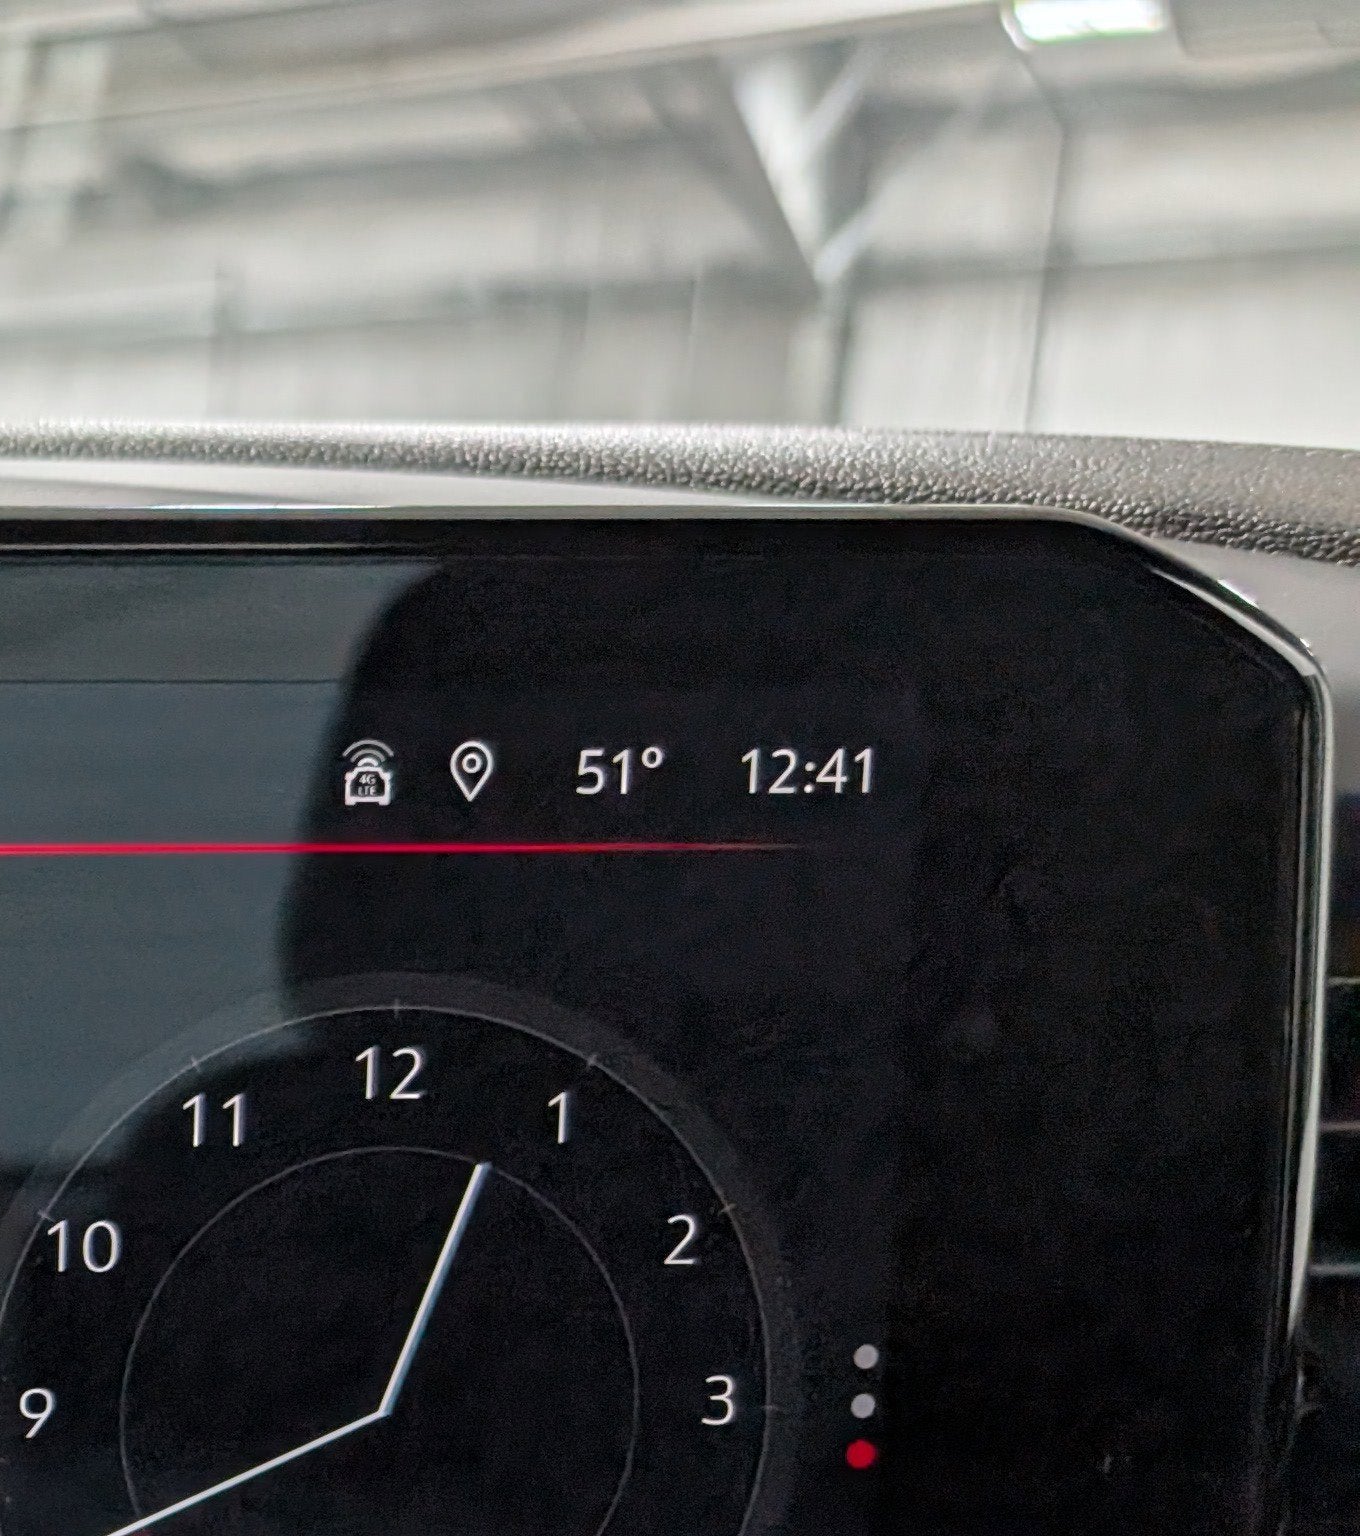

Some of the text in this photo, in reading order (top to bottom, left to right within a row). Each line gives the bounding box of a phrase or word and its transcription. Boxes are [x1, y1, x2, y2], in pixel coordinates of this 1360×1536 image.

[575, 746, 665, 795] 51°
[741, 747, 873, 794] 12:41
[355, 1046, 423, 1100] 12
[182, 1094, 243, 1148] 11
[548, 1091, 568, 1144] 1
[47, 1220, 120, 1273] 10
[663, 1214, 697, 1265] 2
[19, 1388, 55, 1439] 9
[701, 1375, 735, 1426] 3
